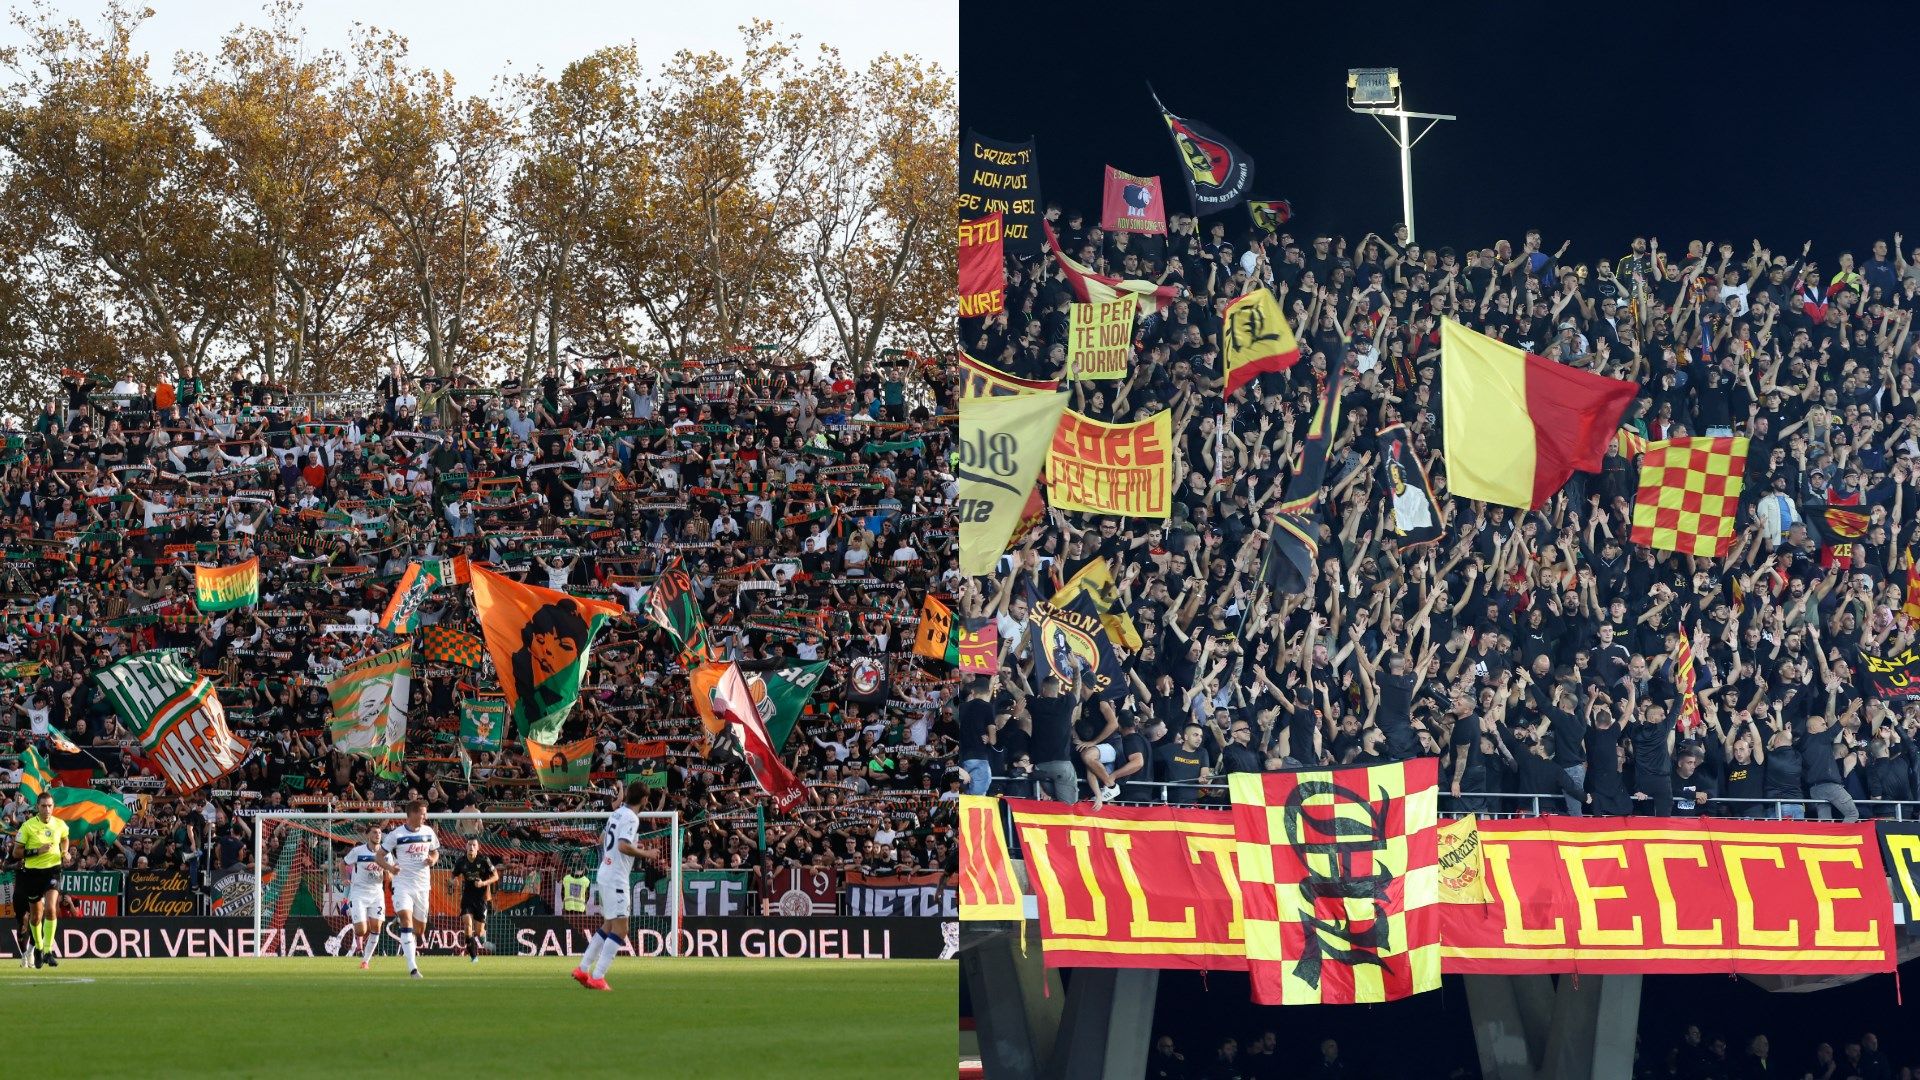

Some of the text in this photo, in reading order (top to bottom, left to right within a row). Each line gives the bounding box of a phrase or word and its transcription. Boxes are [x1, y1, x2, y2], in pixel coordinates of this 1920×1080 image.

[1012, 199, 1035, 214] SEI
[1004, 224, 1028, 239] NOI
[1077, 299, 1132, 325] IO PER
[1076, 323, 1129, 349] TE NON
[1076, 349, 1127, 374] DORMO
[1052, 411, 1164, 466] CORE
[267, 626, 297, 635] VENEZIA
[578, 824, 597, 832] MARE
[237, 873, 256, 882] MAGG
[1022, 826, 1246, 940] ULT
[1482, 842, 1880, 948] LECCE
[129, 893, 193, 914] Maggio
[214, 893, 256, 916] DIFFID
[376, 906, 382, 915] 2
[555, 880, 743, 917] GATE
[160, 929, 315, 958] VENEZIA
[740, 928, 890, 959] GIOIELLI
